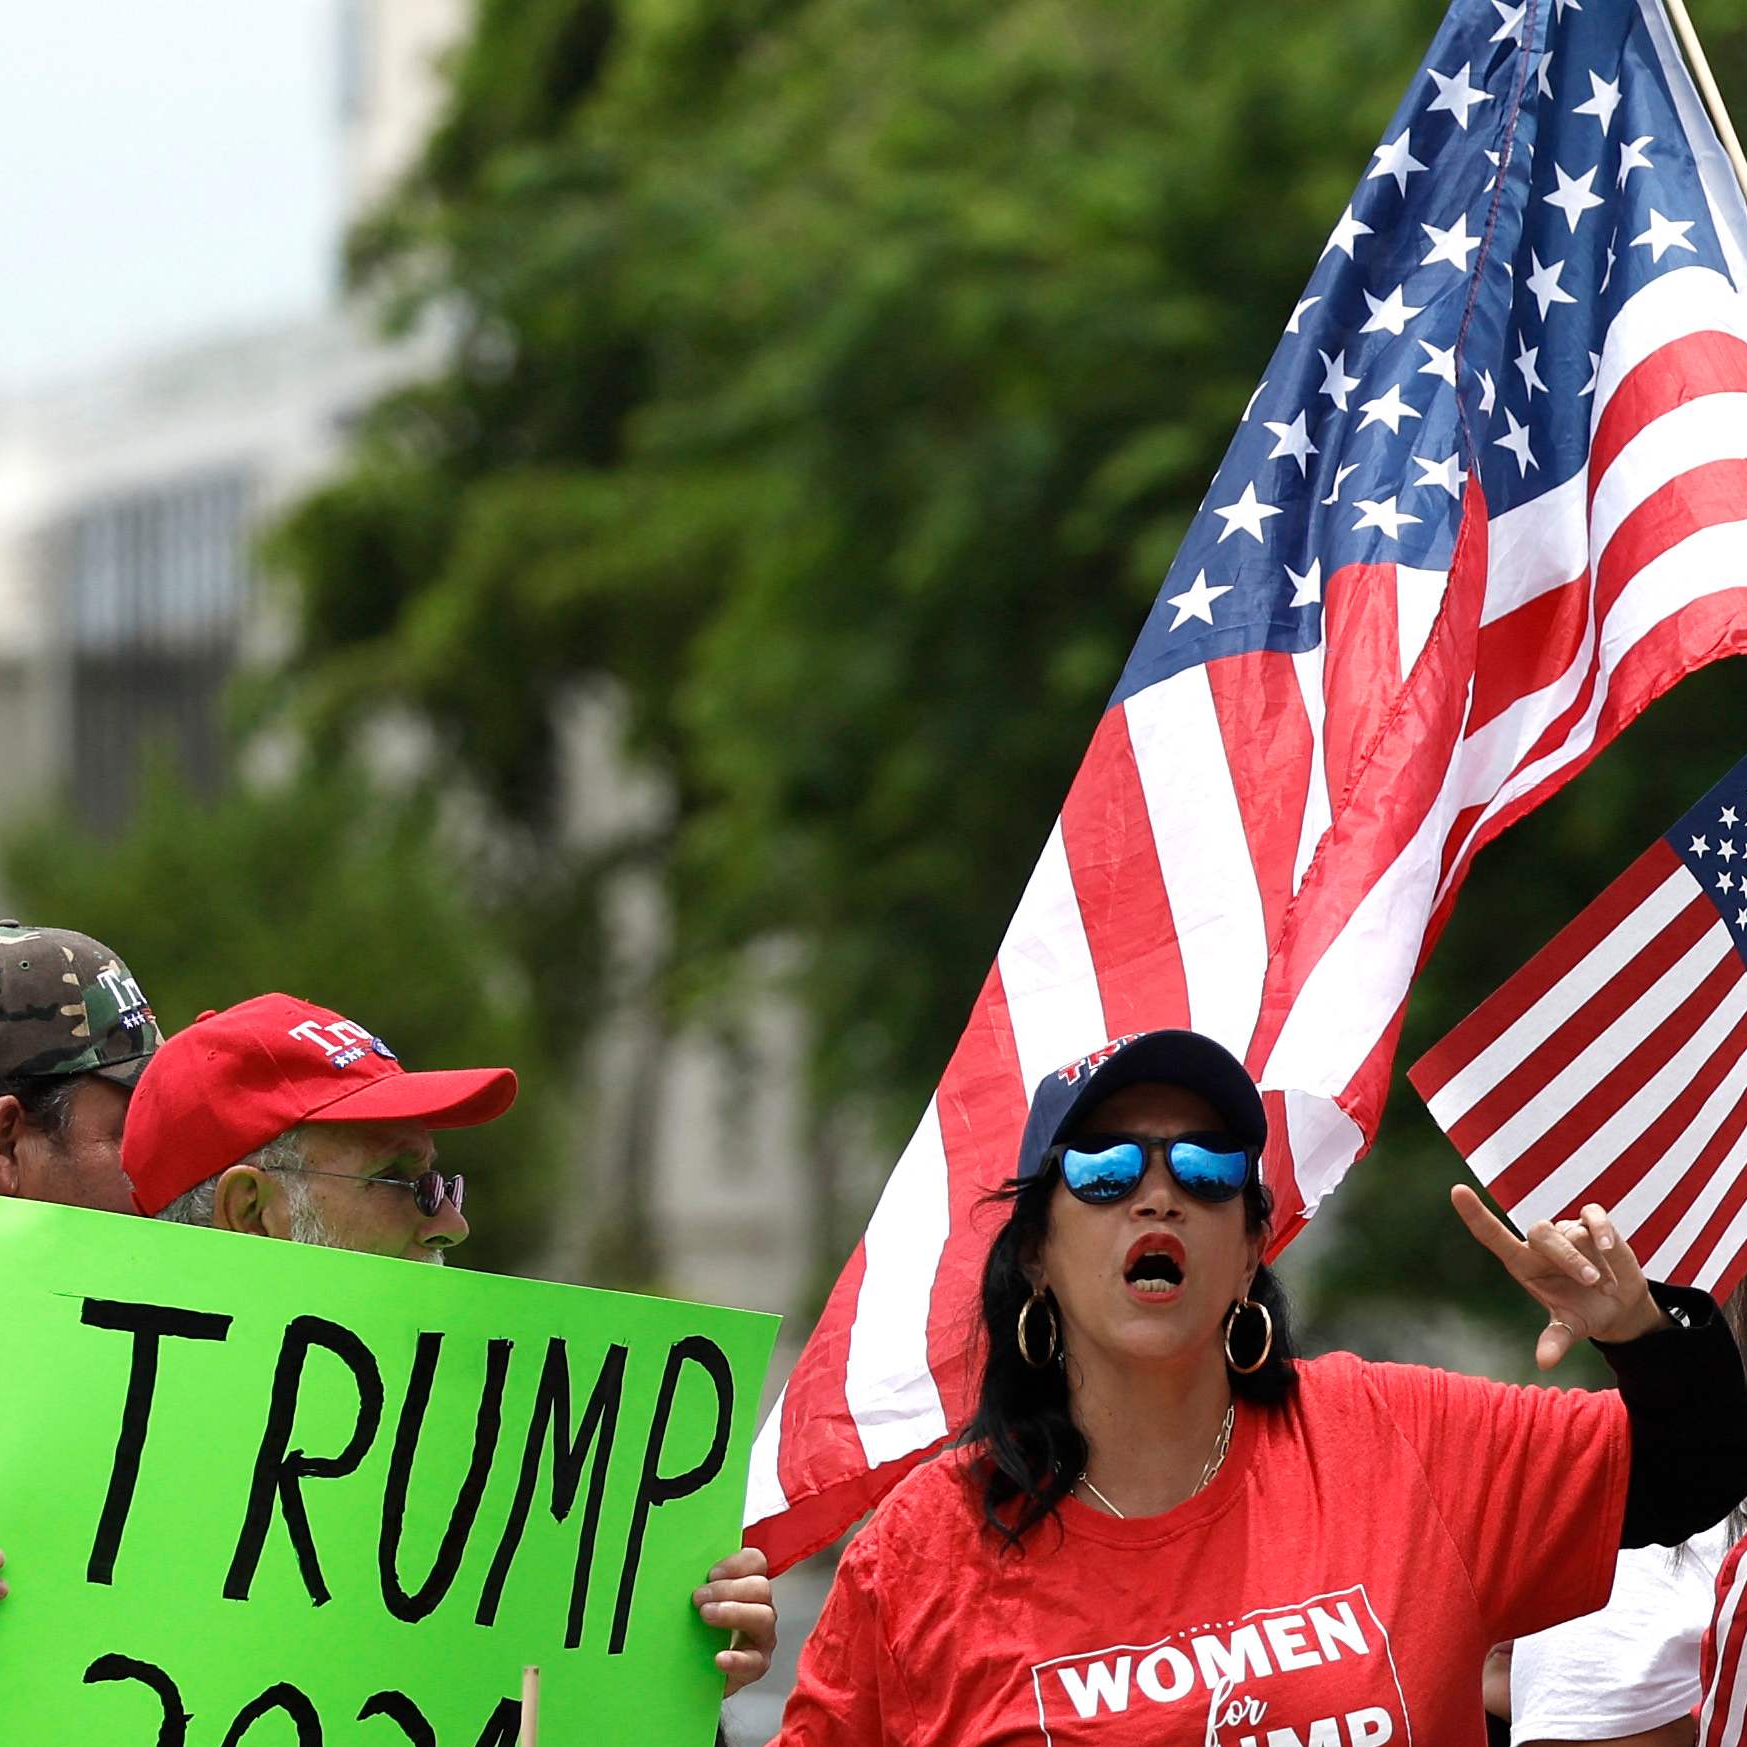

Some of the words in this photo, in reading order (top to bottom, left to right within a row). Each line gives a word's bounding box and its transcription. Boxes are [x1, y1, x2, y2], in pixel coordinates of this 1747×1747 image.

[288, 1020, 373, 1056] Tru
[1057, 1033, 1146, 1086] TR
[81, 1298, 735, 1654] TRUMP
[1056, 1600, 1370, 1720] WOMEN
